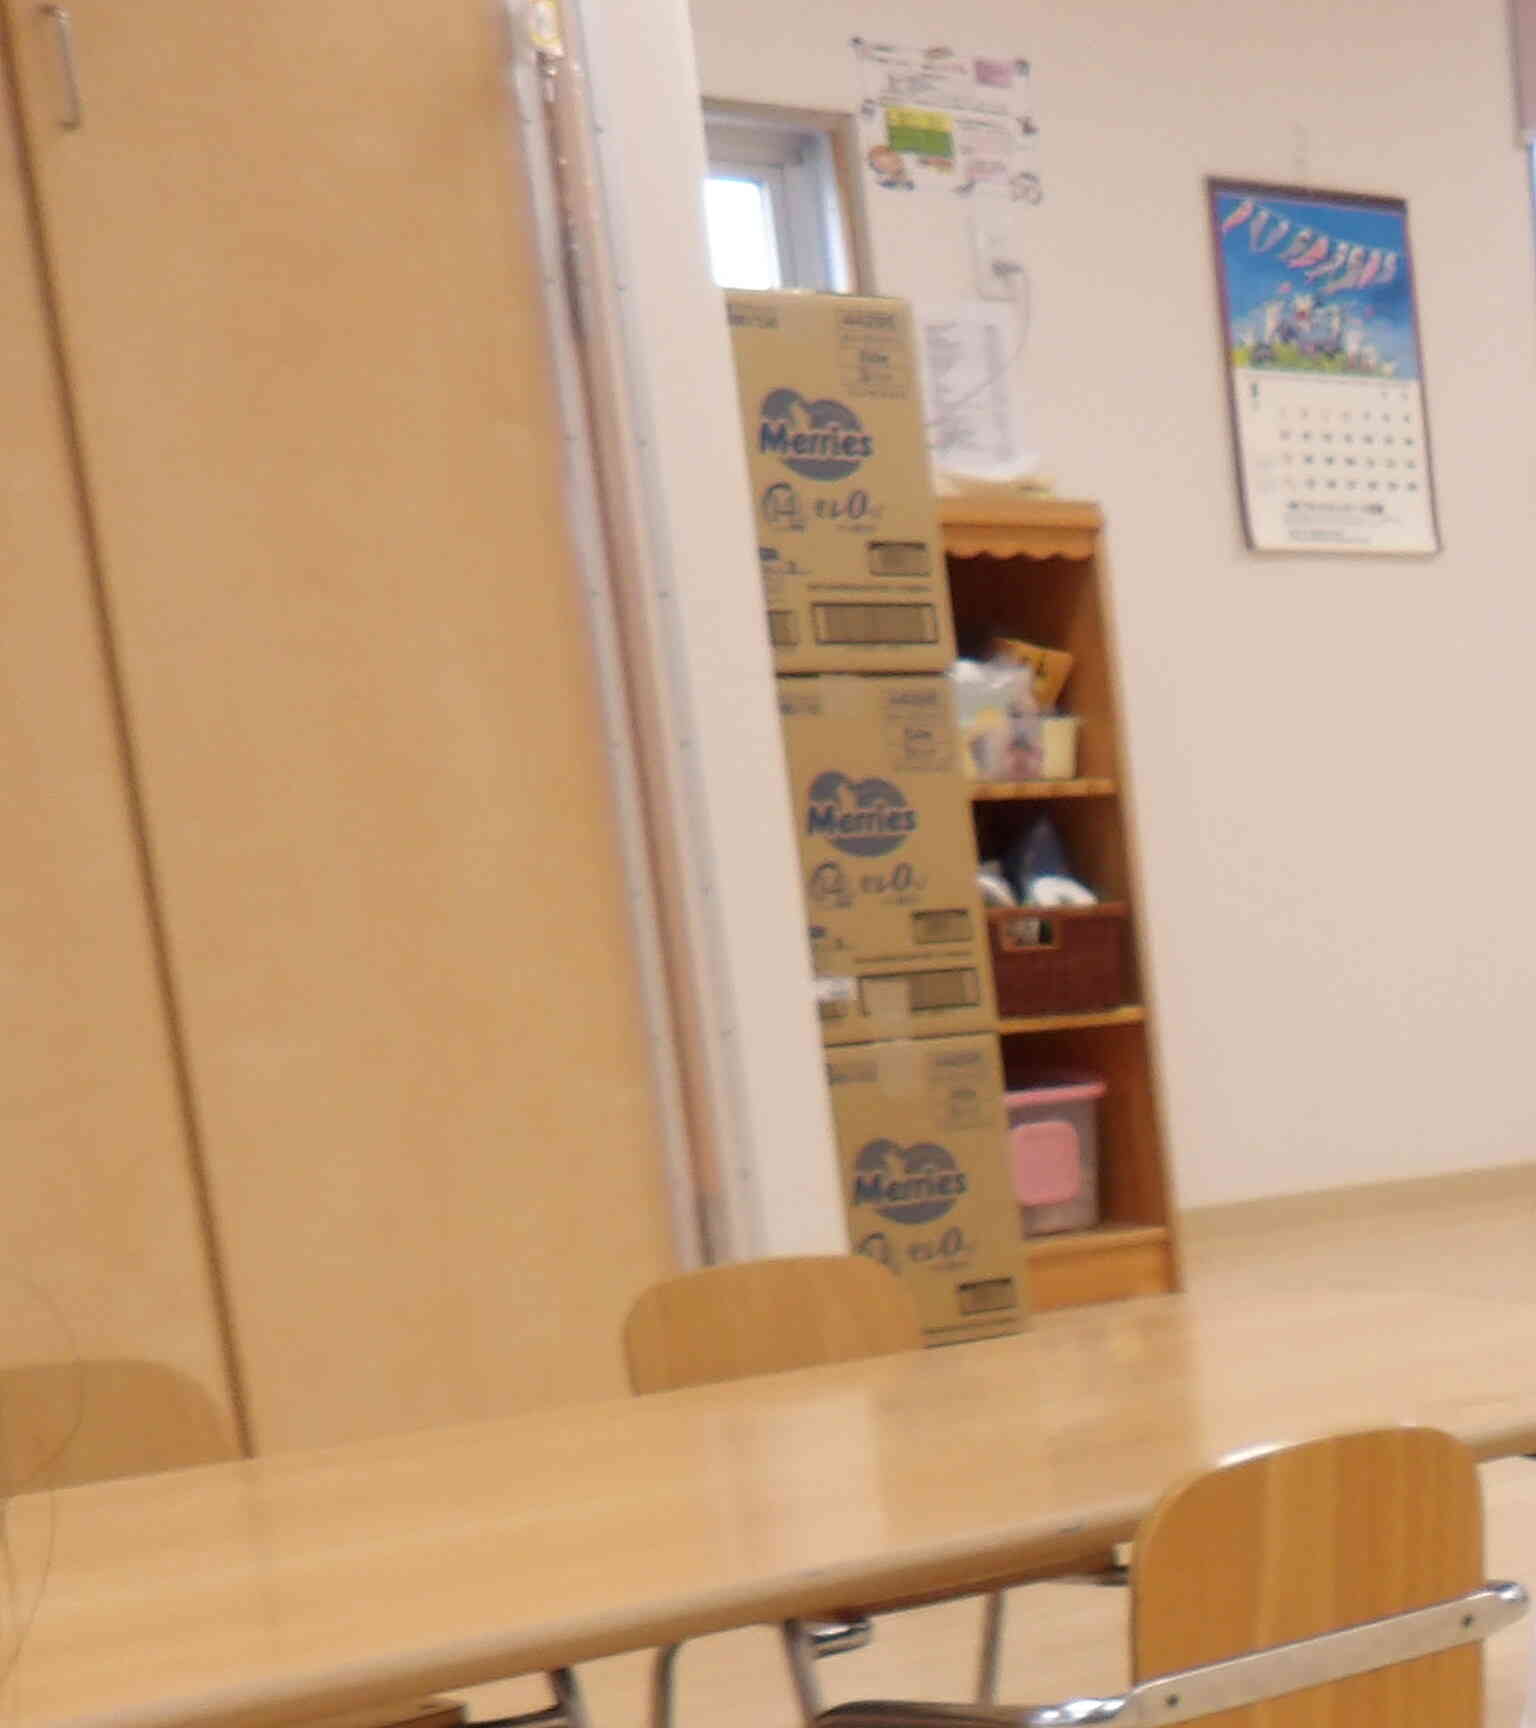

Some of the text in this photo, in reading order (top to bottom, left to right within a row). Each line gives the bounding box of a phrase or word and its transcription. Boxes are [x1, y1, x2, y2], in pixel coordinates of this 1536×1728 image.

[760, 423, 873, 457] Merries
[807, 804, 917, 835] Merries
[854, 1173, 967, 1205] Merries
